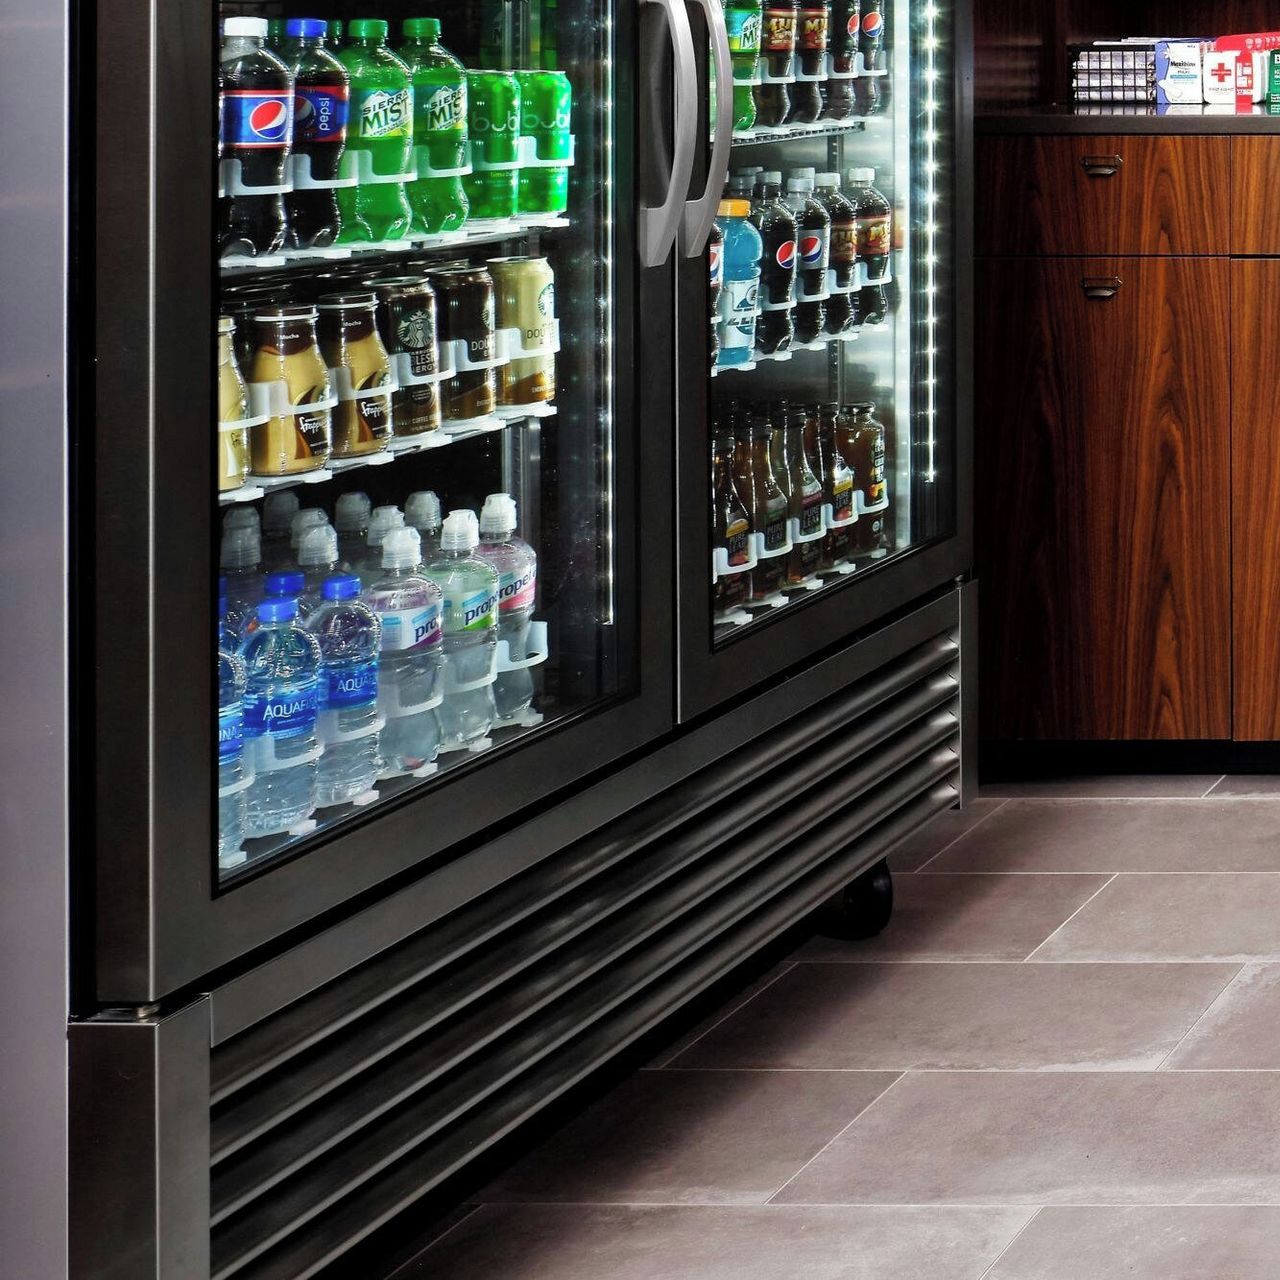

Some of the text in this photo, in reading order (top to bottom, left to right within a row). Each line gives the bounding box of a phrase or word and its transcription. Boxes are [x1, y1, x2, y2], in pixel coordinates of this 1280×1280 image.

[318, 96, 331, 132] pepsi
[342, 319, 362, 329] Mocha
[279, 332, 300, 341] Mocha
